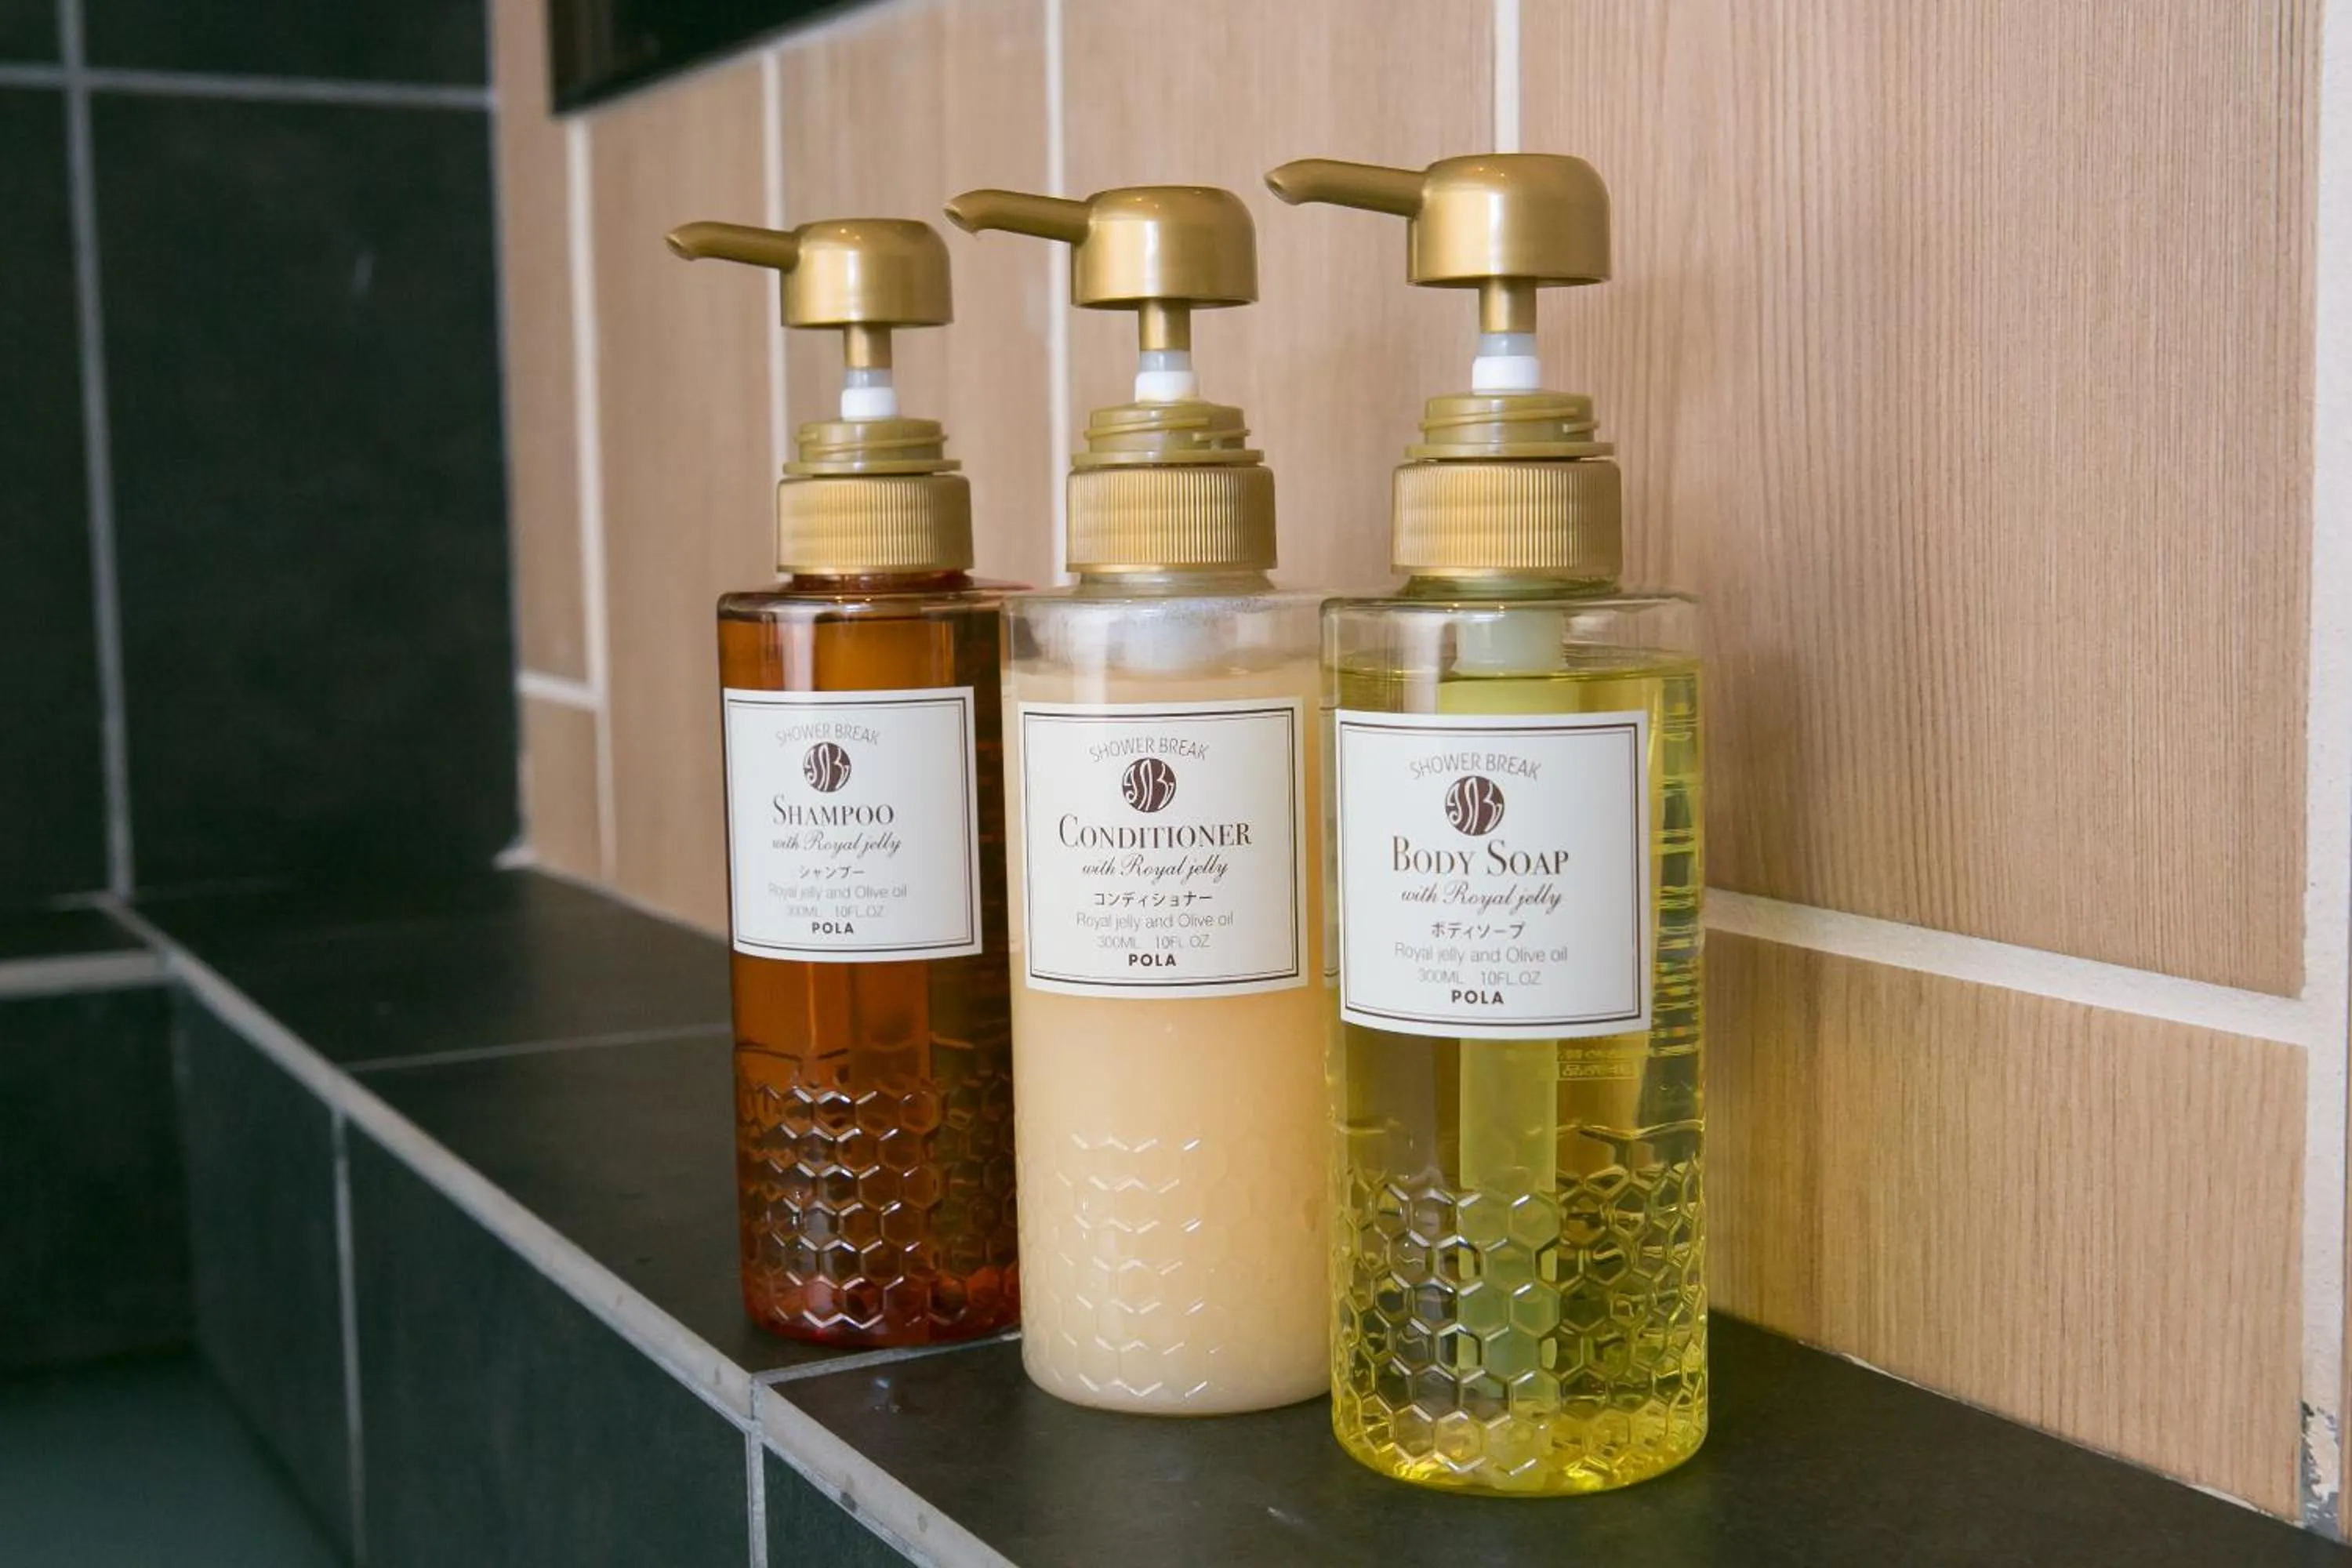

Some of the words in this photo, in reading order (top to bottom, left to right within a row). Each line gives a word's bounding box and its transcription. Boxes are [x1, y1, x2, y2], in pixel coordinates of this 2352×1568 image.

[775, 723, 830, 746] SHOWER
[835, 723, 880, 746] BREAK
[1089, 737, 1154, 762] SHOWER
[1160, 737, 1209, 760] BREAK
[1410, 752, 1481, 779] SHOWER
[1486, 753, 1541, 782] BREAK
[772, 794, 895, 826] SHAMPOO
[1059, 813, 1252, 849] CONDITIONER
[773, 832, 800, 850] with
[803, 831, 862, 858] Royal
[862, 831, 902, 858] jelly
[1392, 835, 1475, 876] BODY
[1486, 840, 1570, 877] SOAP
[798, 865, 866, 879] シャンプー
[1082, 856, 1116, 877] with
[1120, 853, 1188, 886] Royal
[1181, 853, 1229, 886] jelly
[826, 885, 851, 899] and
[855, 884, 888, 899] Olive
[892, 884, 907, 898] oil
[1094, 891, 1214, 908] コンディショナー
[1401, 882, 1438, 904] with
[1442, 880, 1515, 915] Royal
[1508, 883, 1563, 915] jelly
[811, 921, 854, 934] POLA
[1076, 913, 1112, 931] Royal
[1115, 913, 1141, 931] jelly
[1145, 914, 1174, 929] and
[1178, 913, 1214, 928] Olive
[1218, 911, 1234, 927] oil
[1431, 920, 1526, 939] ボディソープ
[1098, 935, 1142, 949] 300ML
[1128, 953, 1177, 967] POLA
[1394, 942, 1433, 963] Royal
[1436, 946, 1465, 965] jelly
[1470, 947, 1501, 963] and
[1506, 946, 1546, 964] Olive
[1550, 946, 1568, 962] oil
[1417, 968, 1465, 984] 300ML
[1451, 989, 1504, 1004] POLA
